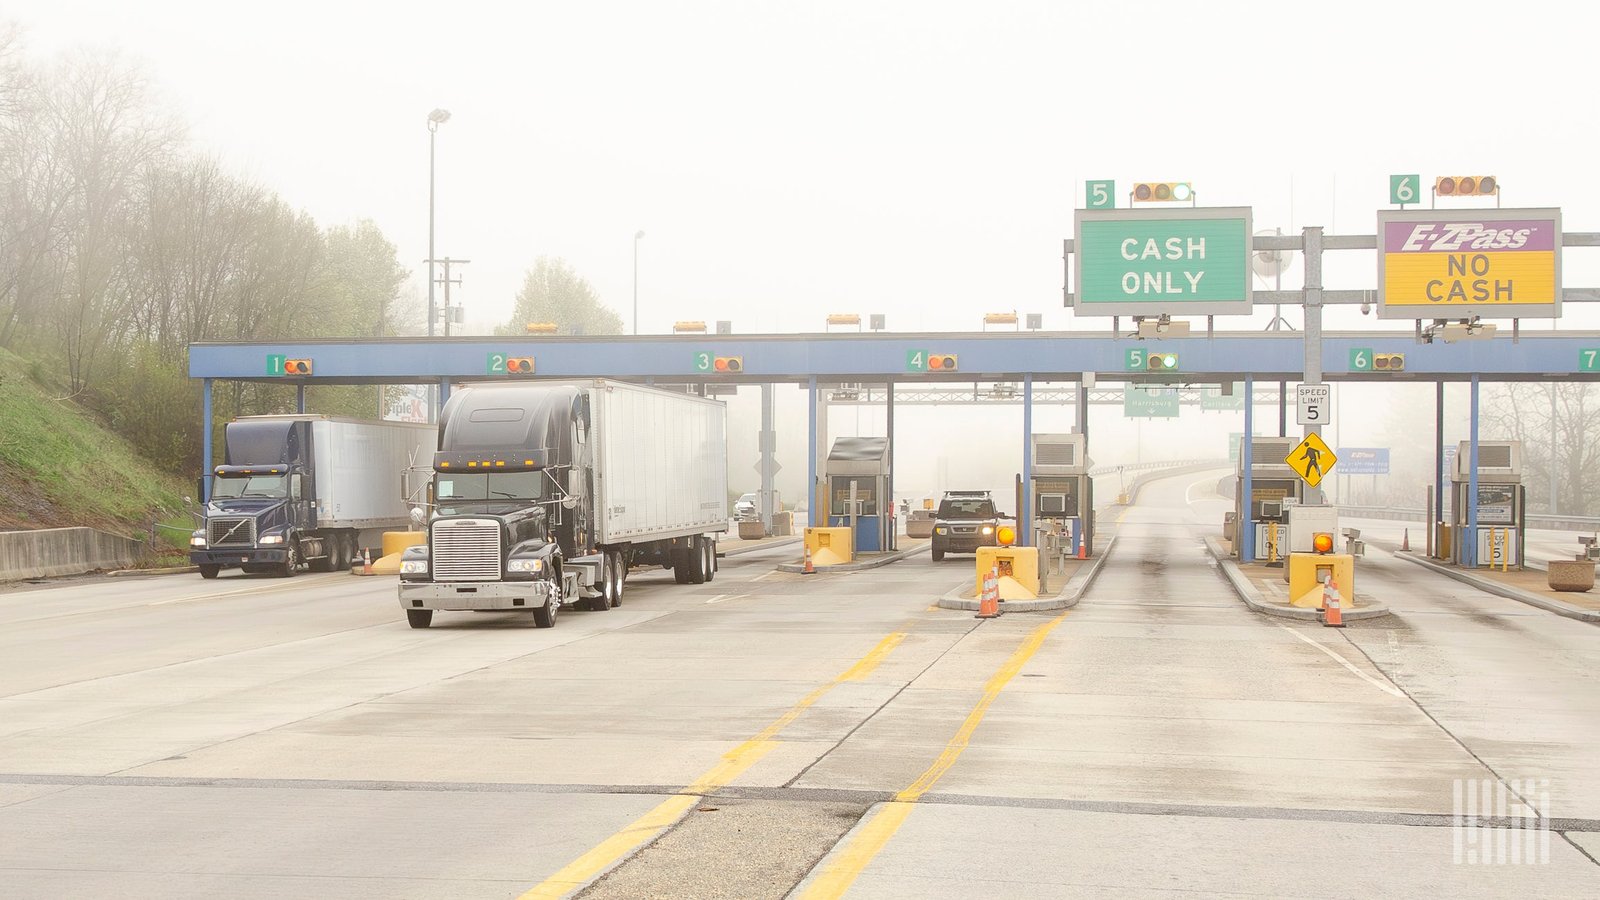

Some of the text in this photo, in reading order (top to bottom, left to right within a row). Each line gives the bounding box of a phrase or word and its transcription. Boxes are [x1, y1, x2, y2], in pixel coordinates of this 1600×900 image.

[1092, 184, 1108, 206] 5
[1397, 177, 1413, 201] 6
[1121, 237, 1206, 261] CASH
[1447, 253, 1490, 276] NO
[1121, 271, 1205, 295] ONLY
[1426, 279, 1514, 302] CASH
[274, 356, 280, 372] 1
[492, 354, 503, 371] 2
[698, 353, 709, 370] 3
[910, 352, 923, 368] 4
[1130, 350, 1142, 368] 5
[1354, 352, 1367, 368] 6
[1584, 351, 1597, 368] 7
[1299, 388, 1328, 396] SPEED
[1302, 397, 1324, 405] LIMIT
[1307, 405, 1320, 420] 5
[1493, 547, 1502, 559] 5
